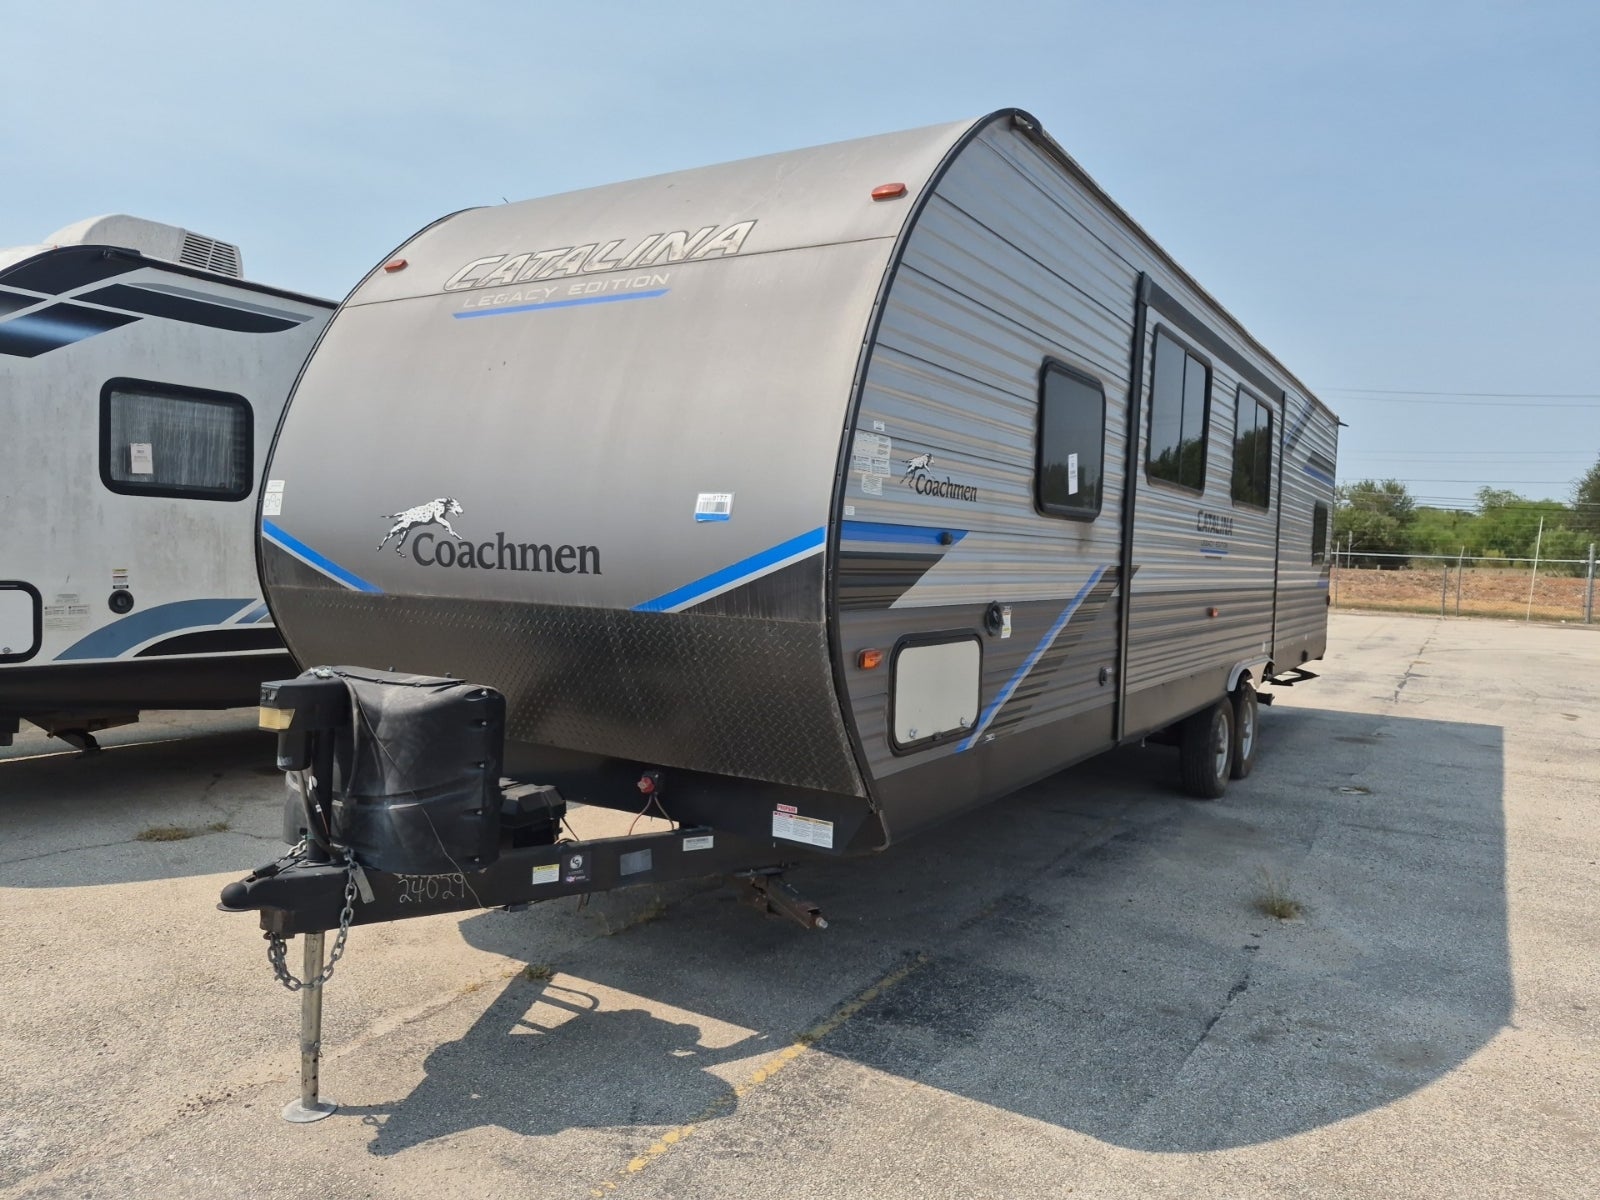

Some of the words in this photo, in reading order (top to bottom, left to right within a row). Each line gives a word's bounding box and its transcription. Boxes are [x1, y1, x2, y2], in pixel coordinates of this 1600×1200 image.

[443, 219, 758, 291] CATALINA
[463, 286, 558, 309] LEGACY
[567, 273, 671, 297] EDITION
[915, 474, 977, 502] Coachmen
[412, 532, 602, 575] Coachmen
[398, 873, 465, 903] 24029
